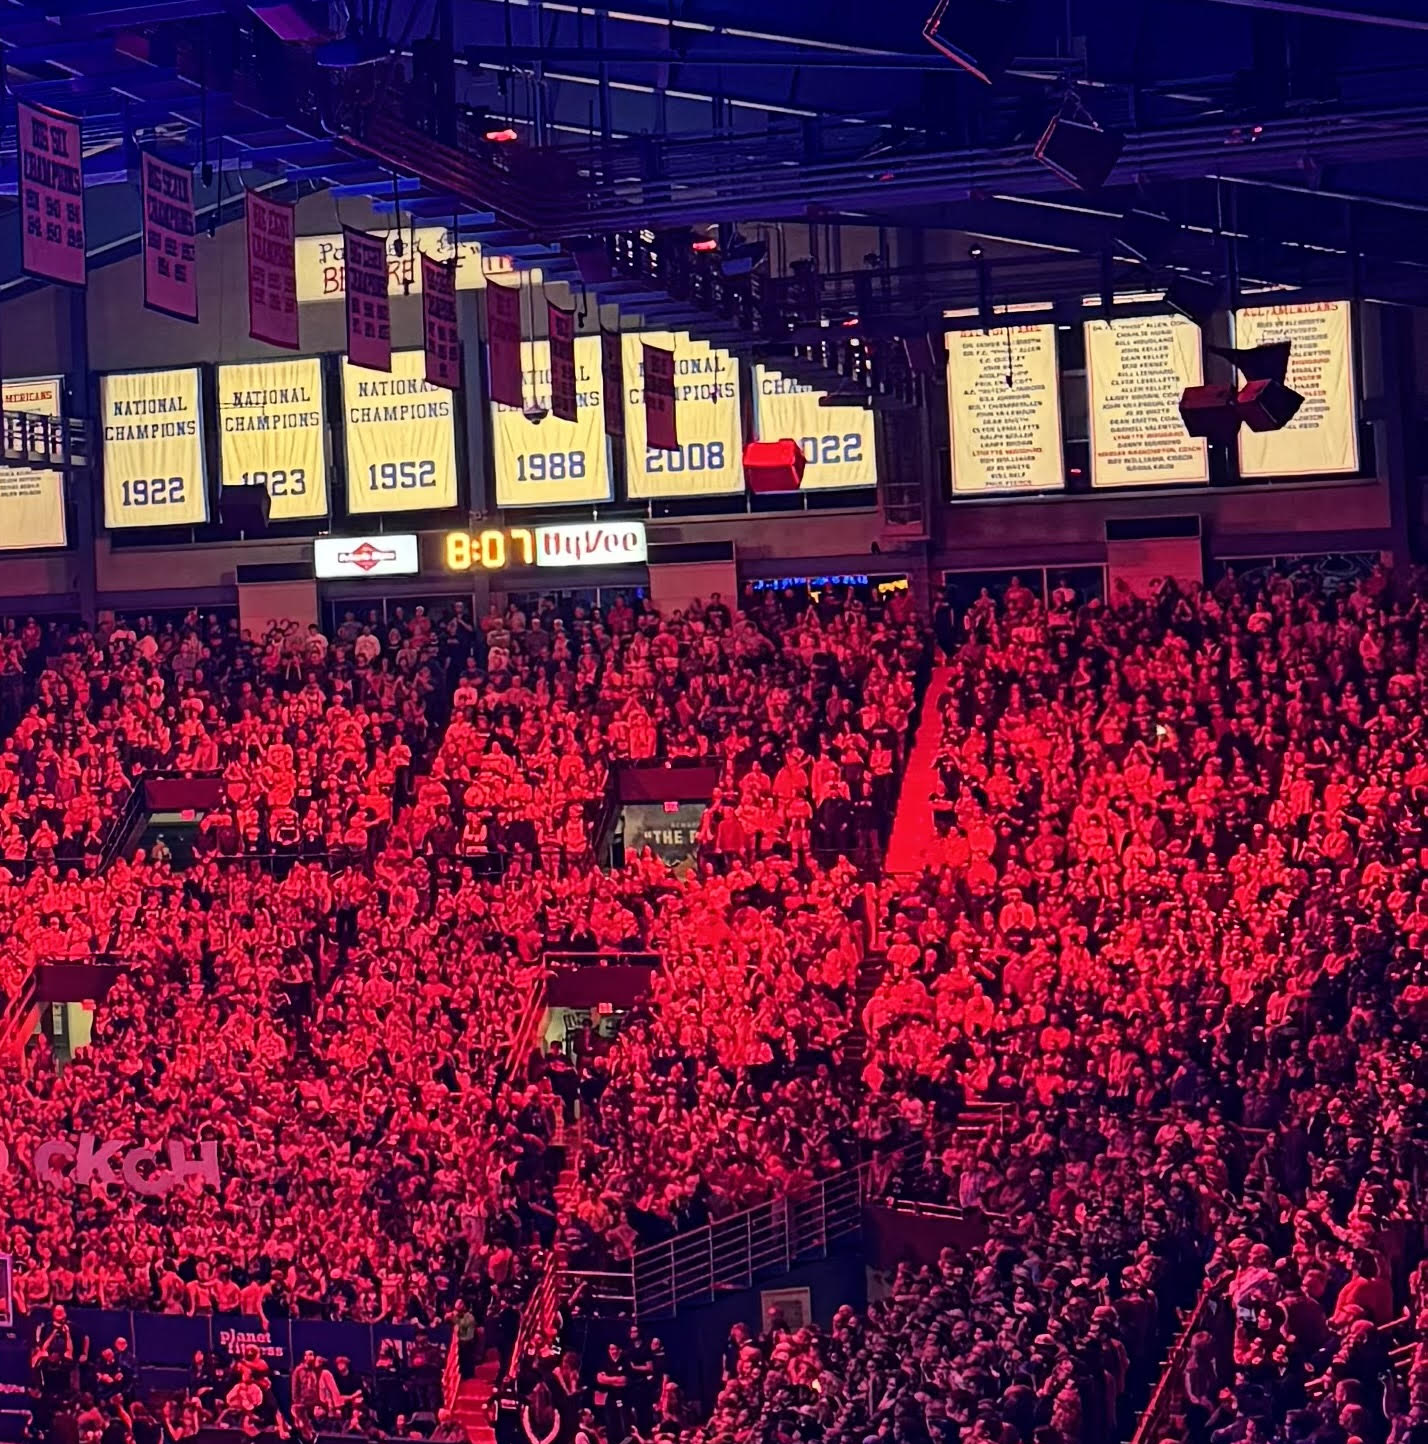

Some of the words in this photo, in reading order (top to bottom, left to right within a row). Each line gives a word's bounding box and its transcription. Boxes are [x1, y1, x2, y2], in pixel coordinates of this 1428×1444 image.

[114, 396, 187, 416] NATIONAL
[233, 387, 311, 408] NATIONAL
[225, 411, 320, 433] CHAMPIONS
[350, 401, 450, 424] CHAMPIONS
[105, 420, 196, 441] CHAMPIONS
[517, 450, 586, 481] 1988
[646, 441, 725, 473] 2008
[368, 460, 437, 491] 1952
[122, 477, 186, 507] 1922
[447, 528, 534, 570] 8:07
[220, 1328, 272, 1345] planet
